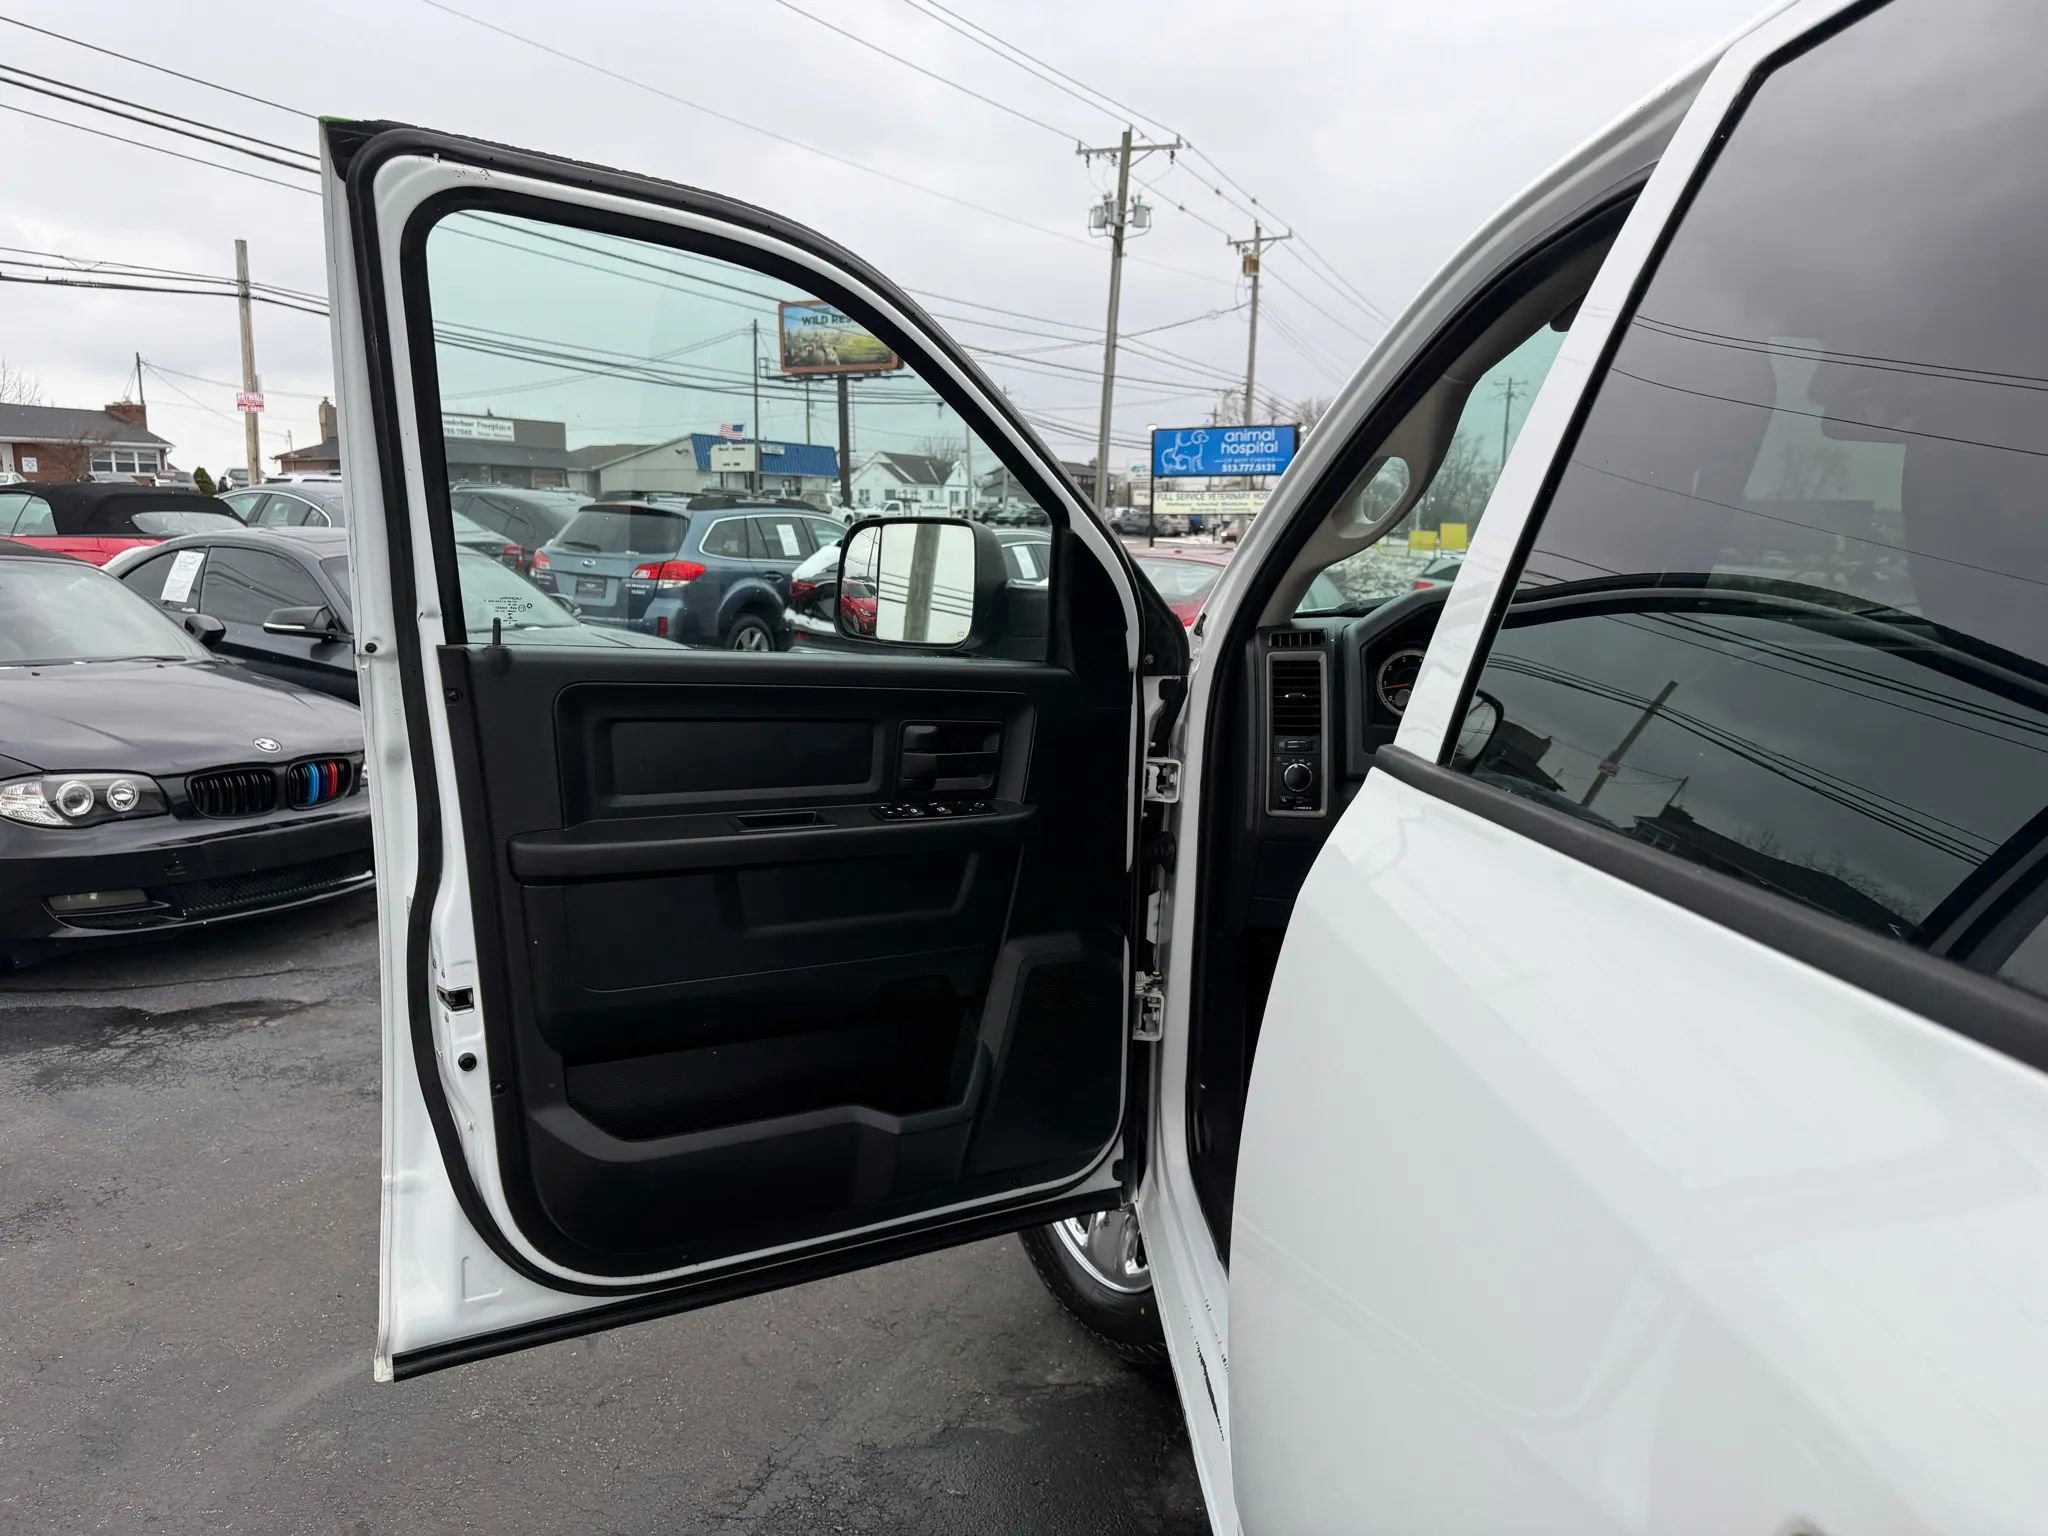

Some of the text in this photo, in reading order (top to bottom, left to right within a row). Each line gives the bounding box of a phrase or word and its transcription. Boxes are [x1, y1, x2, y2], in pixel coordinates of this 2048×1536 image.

[802, 314, 853, 325] WILD RES
[1224, 429, 1275, 442] animal
[1220, 440, 1279, 456] hospital
[1221, 463, 1276, 472] 513.777.5131
[1156, 493, 1174, 501] FULL
[1175, 493, 1206, 501] SERVICE
[1208, 492, 1250, 501] VETERINARY
